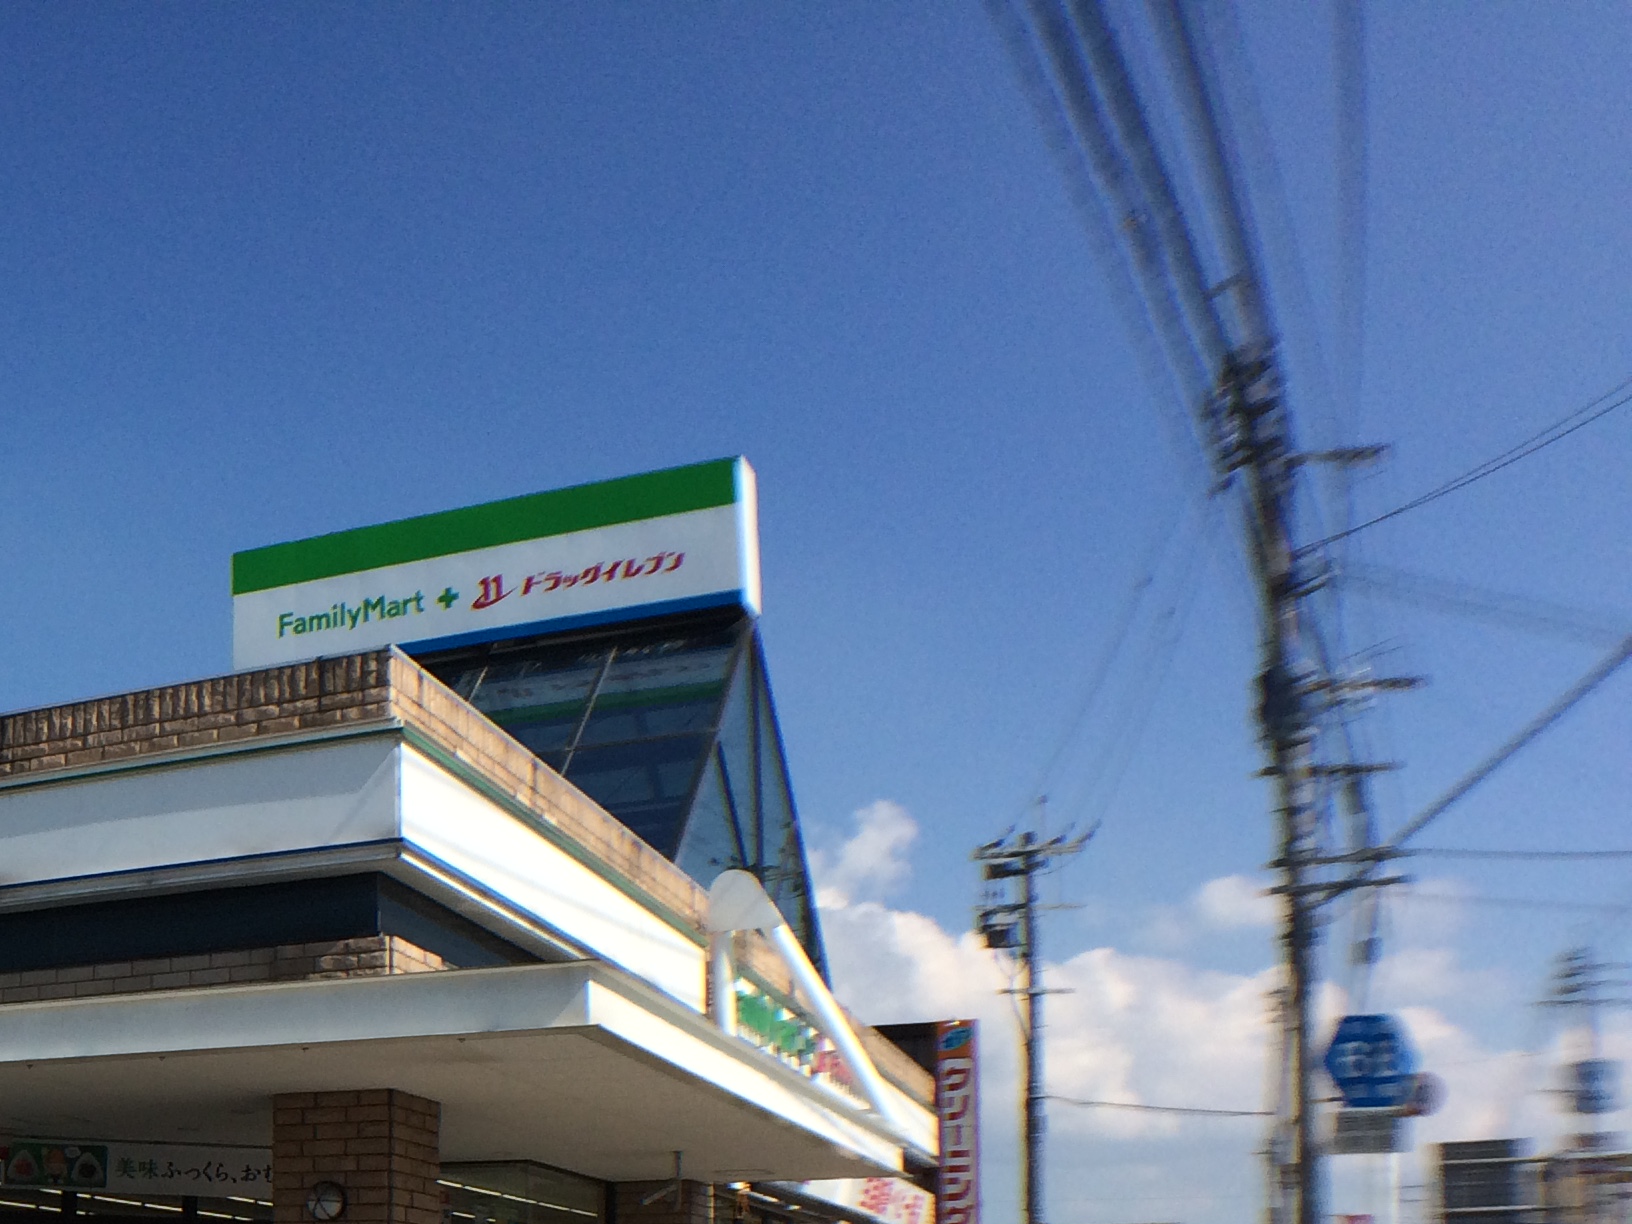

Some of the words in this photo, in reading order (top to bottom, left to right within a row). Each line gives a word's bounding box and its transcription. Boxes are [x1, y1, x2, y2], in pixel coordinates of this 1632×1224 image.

[276, 590, 425, 639] FamilyMart
[521, 551, 686, 597] ドラッグイレブン
